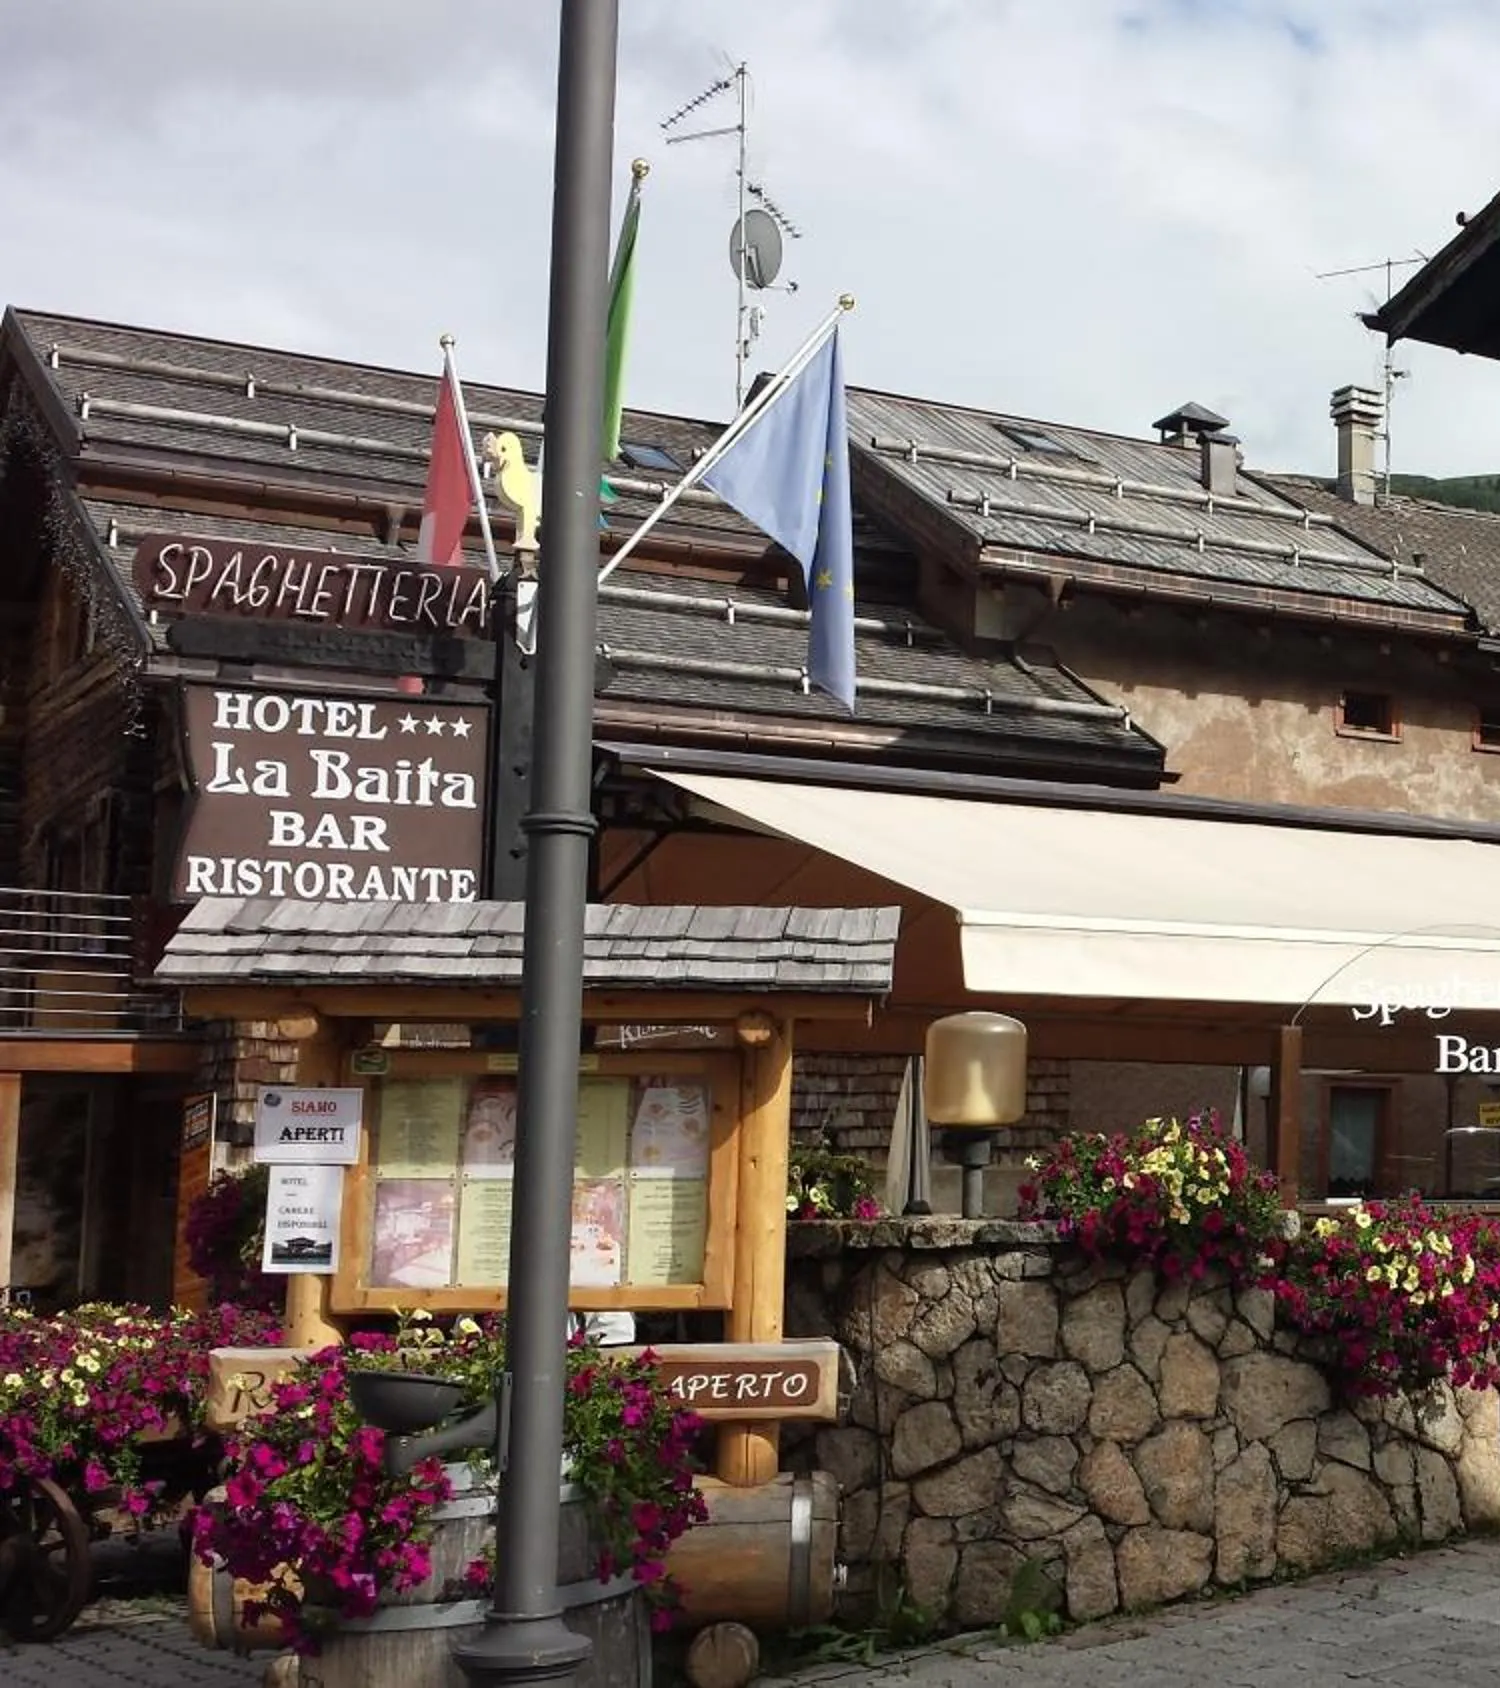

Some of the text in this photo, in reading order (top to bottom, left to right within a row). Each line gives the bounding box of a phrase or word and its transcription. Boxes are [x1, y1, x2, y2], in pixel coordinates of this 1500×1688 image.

[153, 543, 488, 628] SPAGHETTERIA
[213, 691, 387, 740] HOTEL
[205, 742, 477, 809] La Baita
[267, 810, 390, 852] BAR
[185, 856, 477, 903] RISTORANTE
[291, 1101, 337, 1113] SIAMO
[279, 1127, 345, 1141] APERTI
[671, 1371, 808, 1400] APERTO
